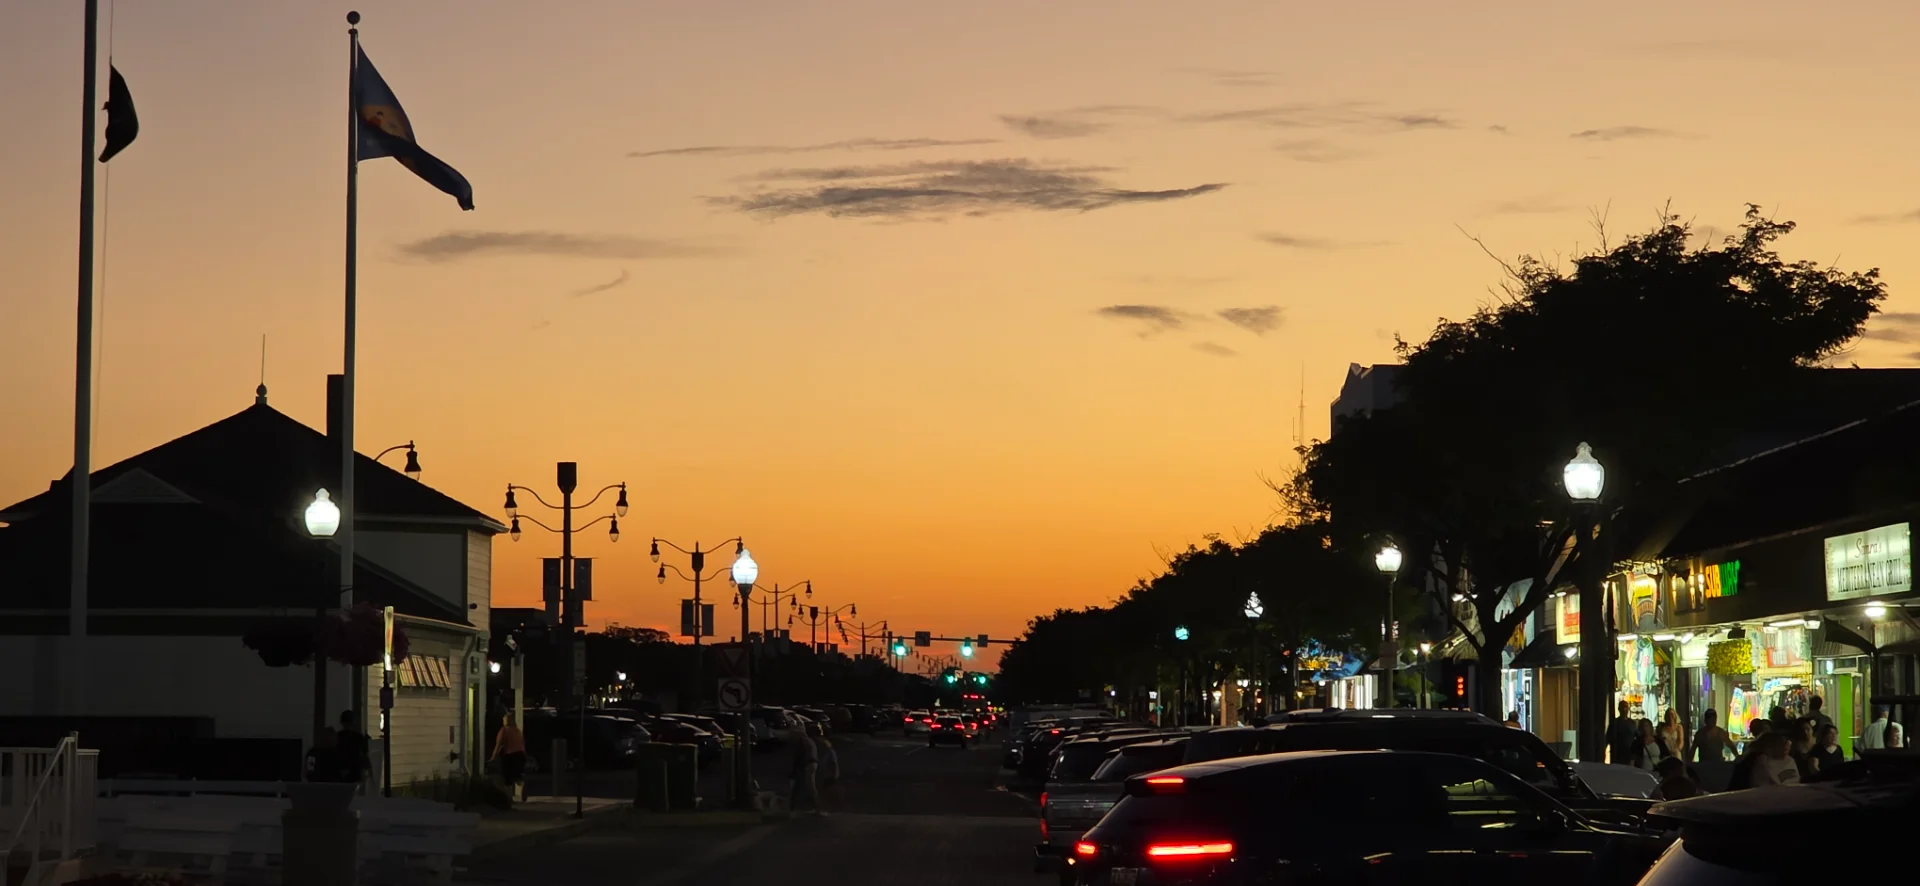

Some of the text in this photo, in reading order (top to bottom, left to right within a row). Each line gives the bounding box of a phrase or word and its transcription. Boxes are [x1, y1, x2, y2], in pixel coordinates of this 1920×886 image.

[1705, 560, 1740, 599] SUBWAY
[1837, 560, 1884, 593] MEDITERRANEAN
[1885, 558, 1902, 586] GRILL
